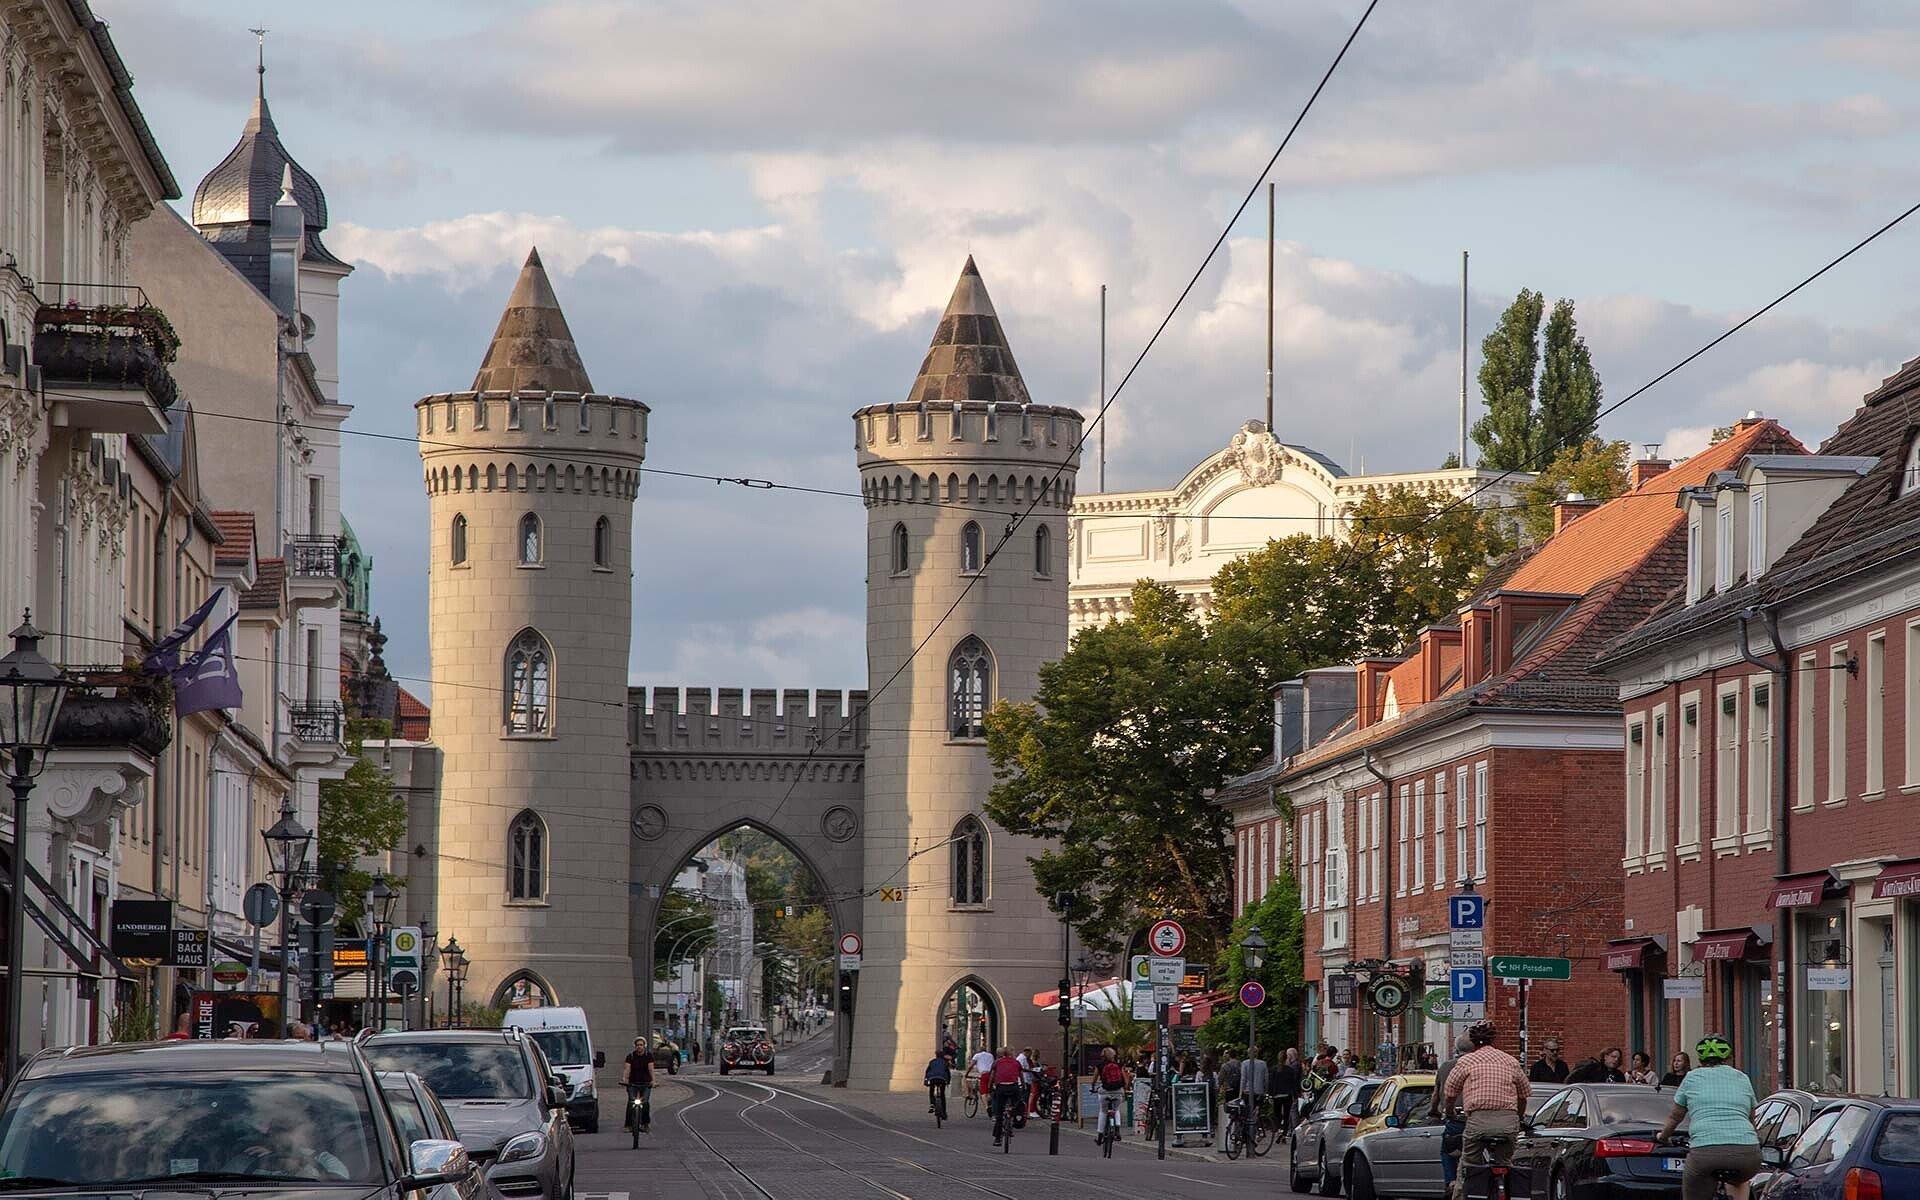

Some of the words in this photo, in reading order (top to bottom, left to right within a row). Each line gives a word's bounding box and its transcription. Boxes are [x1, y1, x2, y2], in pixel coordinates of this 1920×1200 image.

[895, 890, 903, 902] 2
[1457, 900, 1476, 925] P
[117, 923, 167, 931] LINDBERGH
[178, 931, 195, 942] BIO
[177, 943, 203, 953] BACK
[177, 954, 203, 965] HAUS
[1522, 965, 1554, 973] Potsdam
[1457, 972, 1477, 999] P
